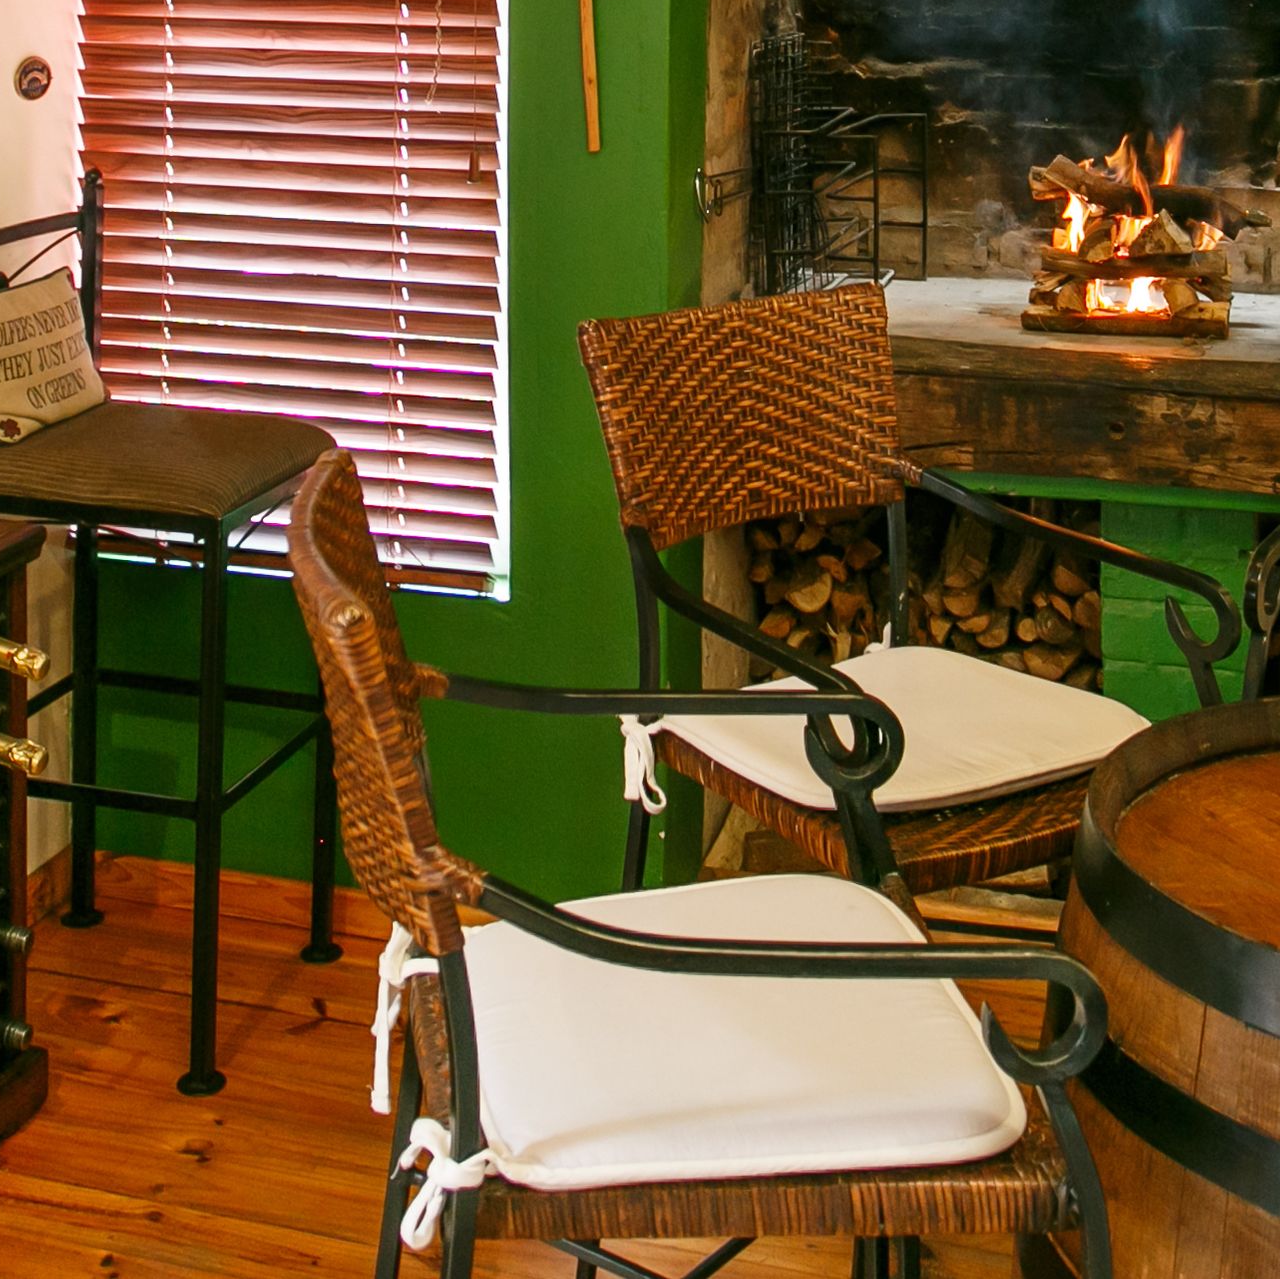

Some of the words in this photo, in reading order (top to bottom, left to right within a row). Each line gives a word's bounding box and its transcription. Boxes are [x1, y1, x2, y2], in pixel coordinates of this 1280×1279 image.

[33, 305, 70, 336] NEVER
[37, 341, 67, 372] JUST
[26, 384, 46, 410] ON
[45, 367, 87, 405] GREENS
